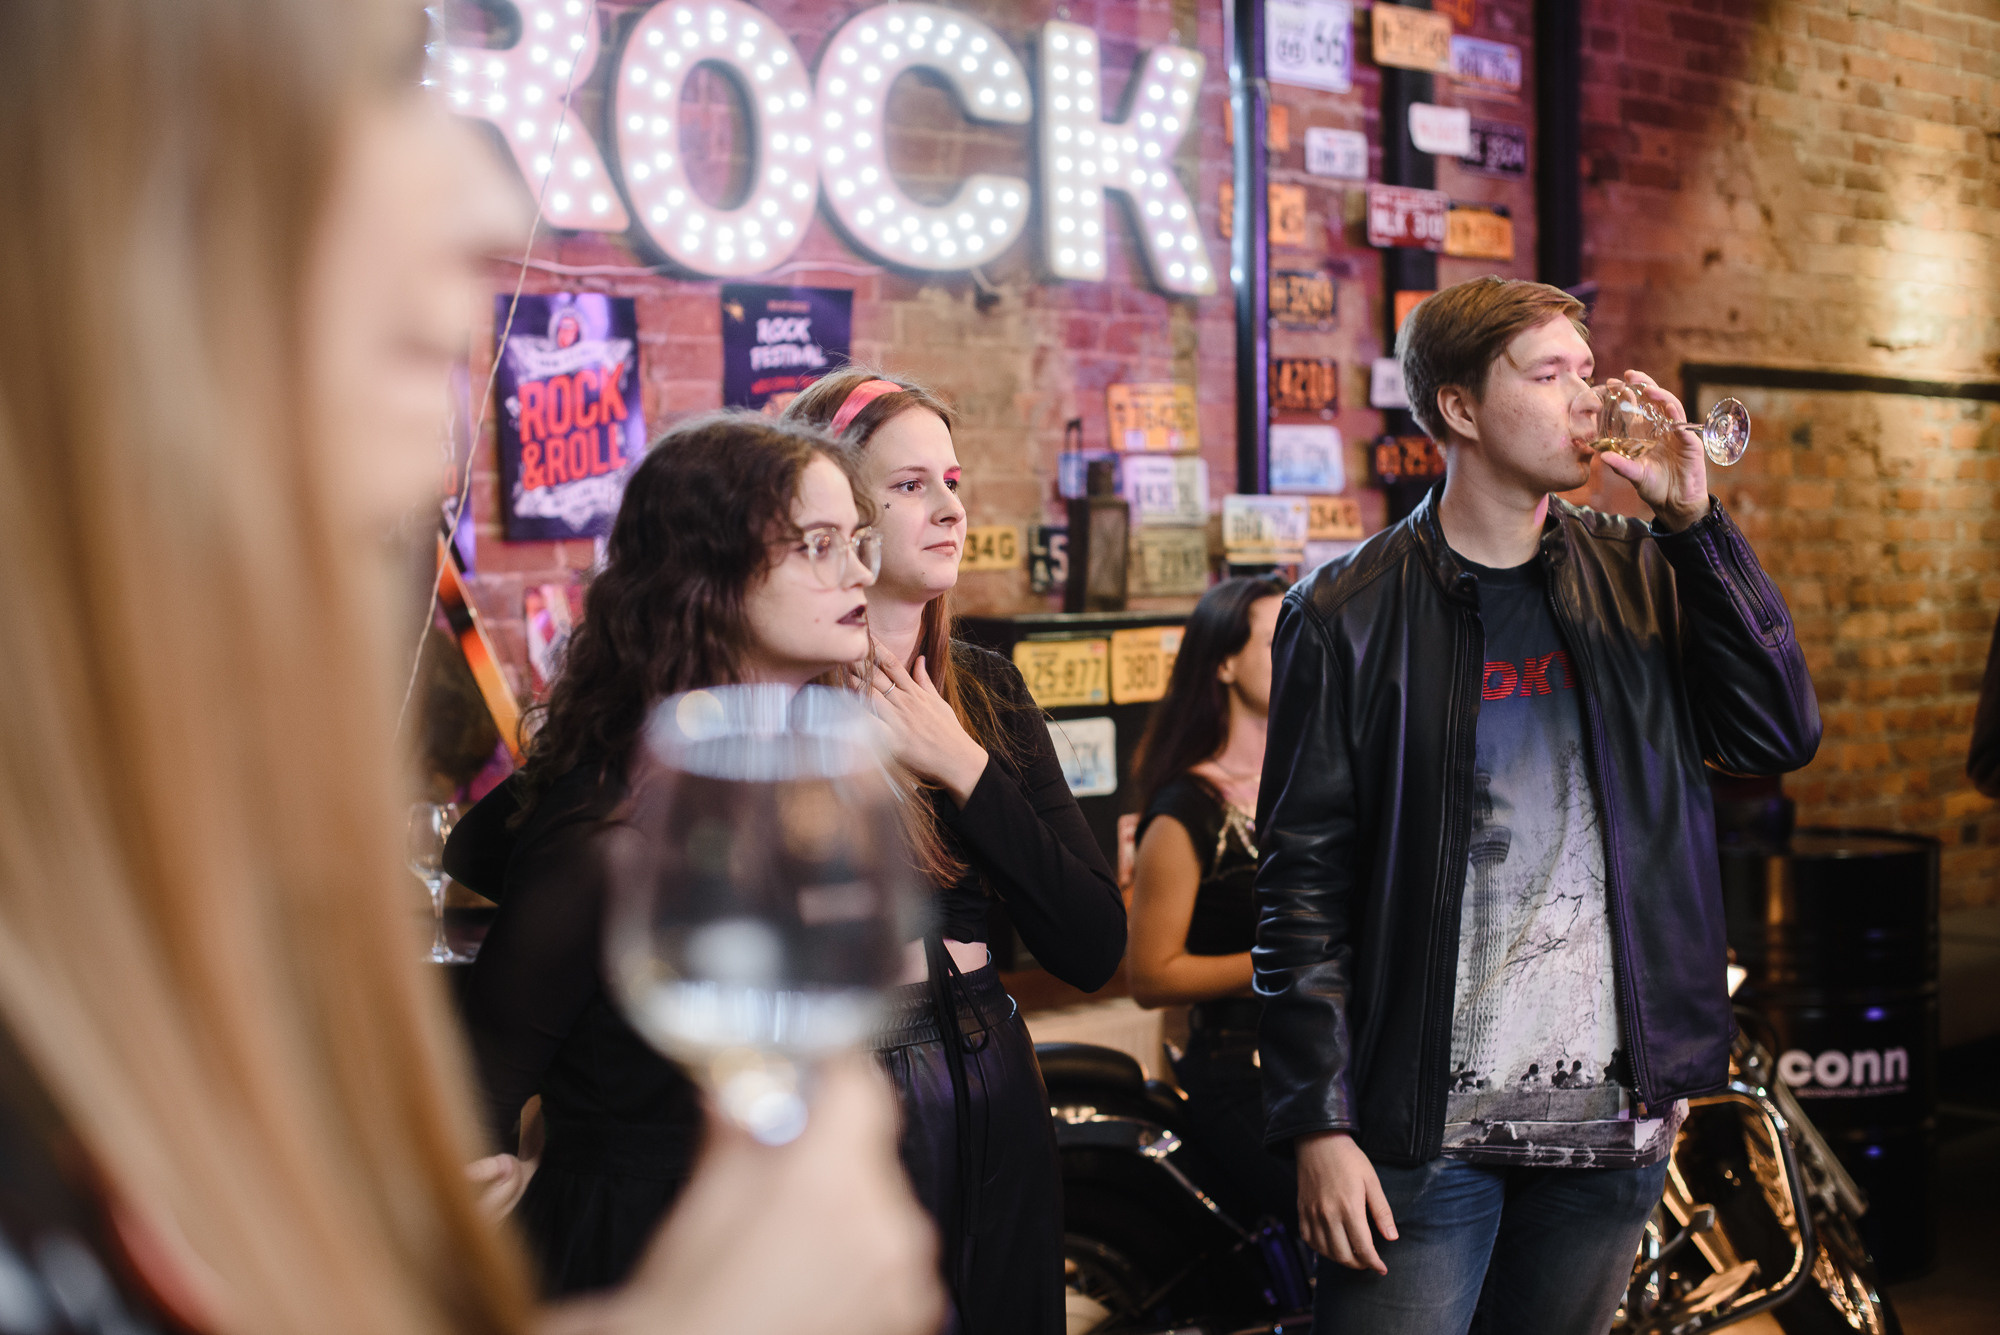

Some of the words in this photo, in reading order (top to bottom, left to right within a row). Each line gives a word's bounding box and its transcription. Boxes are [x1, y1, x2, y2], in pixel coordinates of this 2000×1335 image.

[440, 0, 1216, 295] ROCK
[749, 343, 829, 371] FESTIVAL
[756, 317, 812, 344] ROCK
[518, 362, 629, 444] ROCK
[522, 423, 628, 491] &ROLL
[1777, 1047, 1909, 1088] conn
